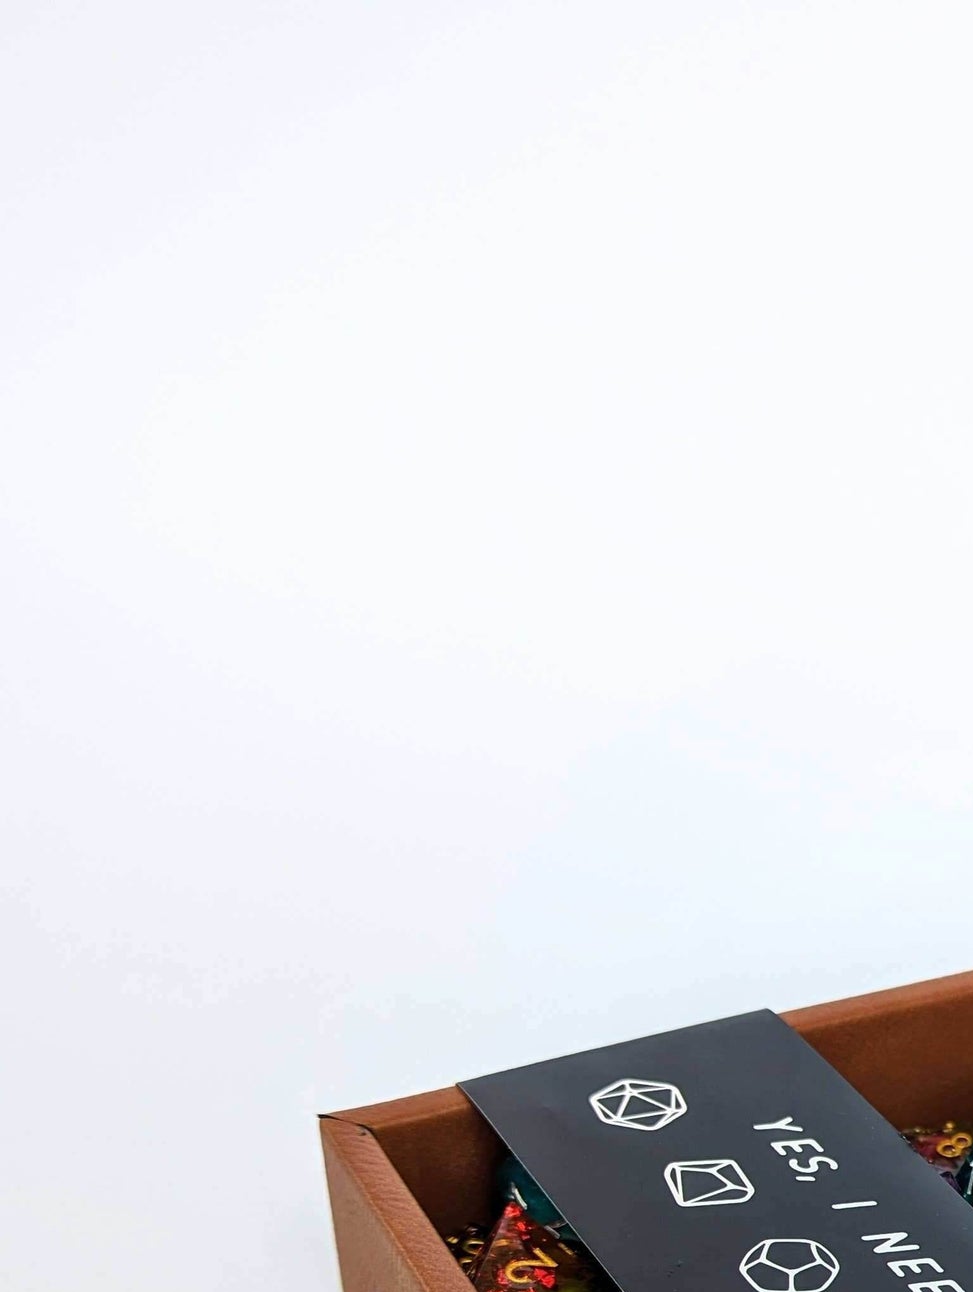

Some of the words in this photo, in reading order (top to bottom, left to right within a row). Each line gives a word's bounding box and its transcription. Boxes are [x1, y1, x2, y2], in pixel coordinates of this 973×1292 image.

[752, 1116, 838, 1181] YES,
[832, 1200, 877, 1210] I
[505, 1247, 559, 1284] 2
